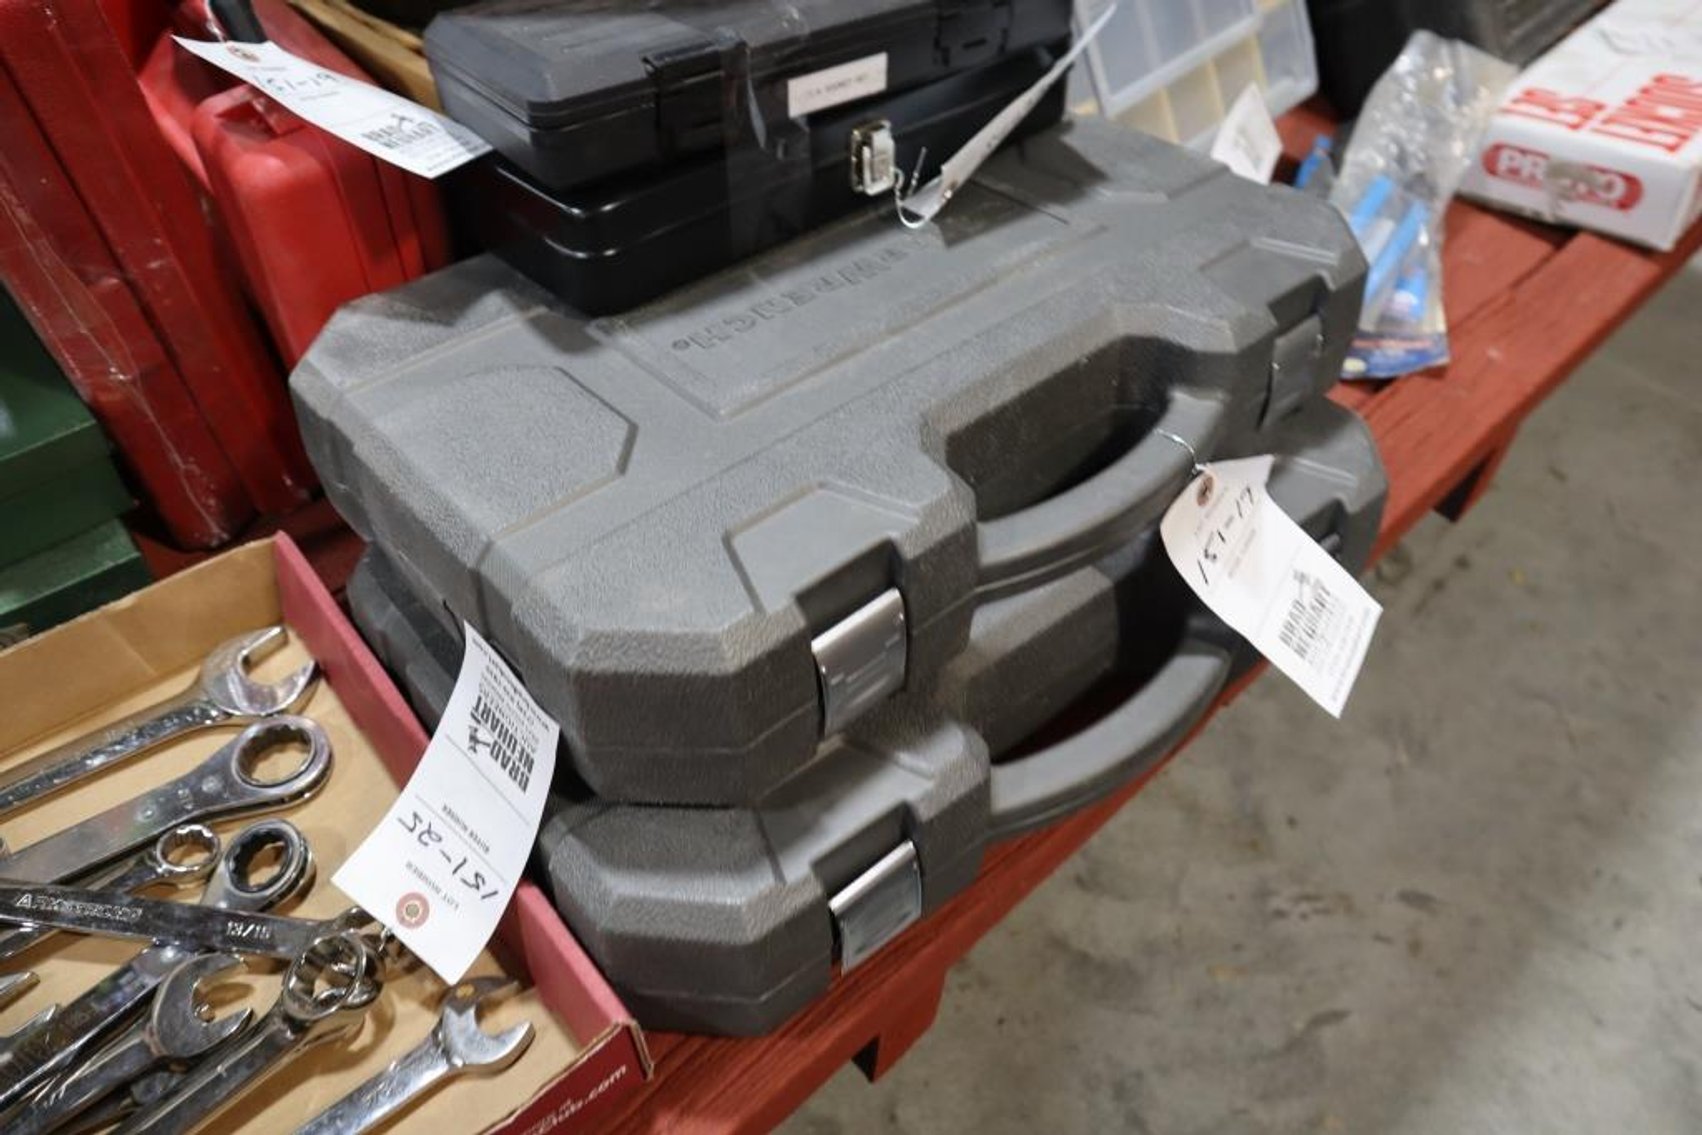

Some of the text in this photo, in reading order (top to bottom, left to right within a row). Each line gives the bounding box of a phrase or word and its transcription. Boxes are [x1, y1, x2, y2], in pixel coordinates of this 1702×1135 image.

[470, 694, 536, 774] NEUHART
[488, 742, 530, 795] BRAD
[396, 809, 500, 901] 151-25
